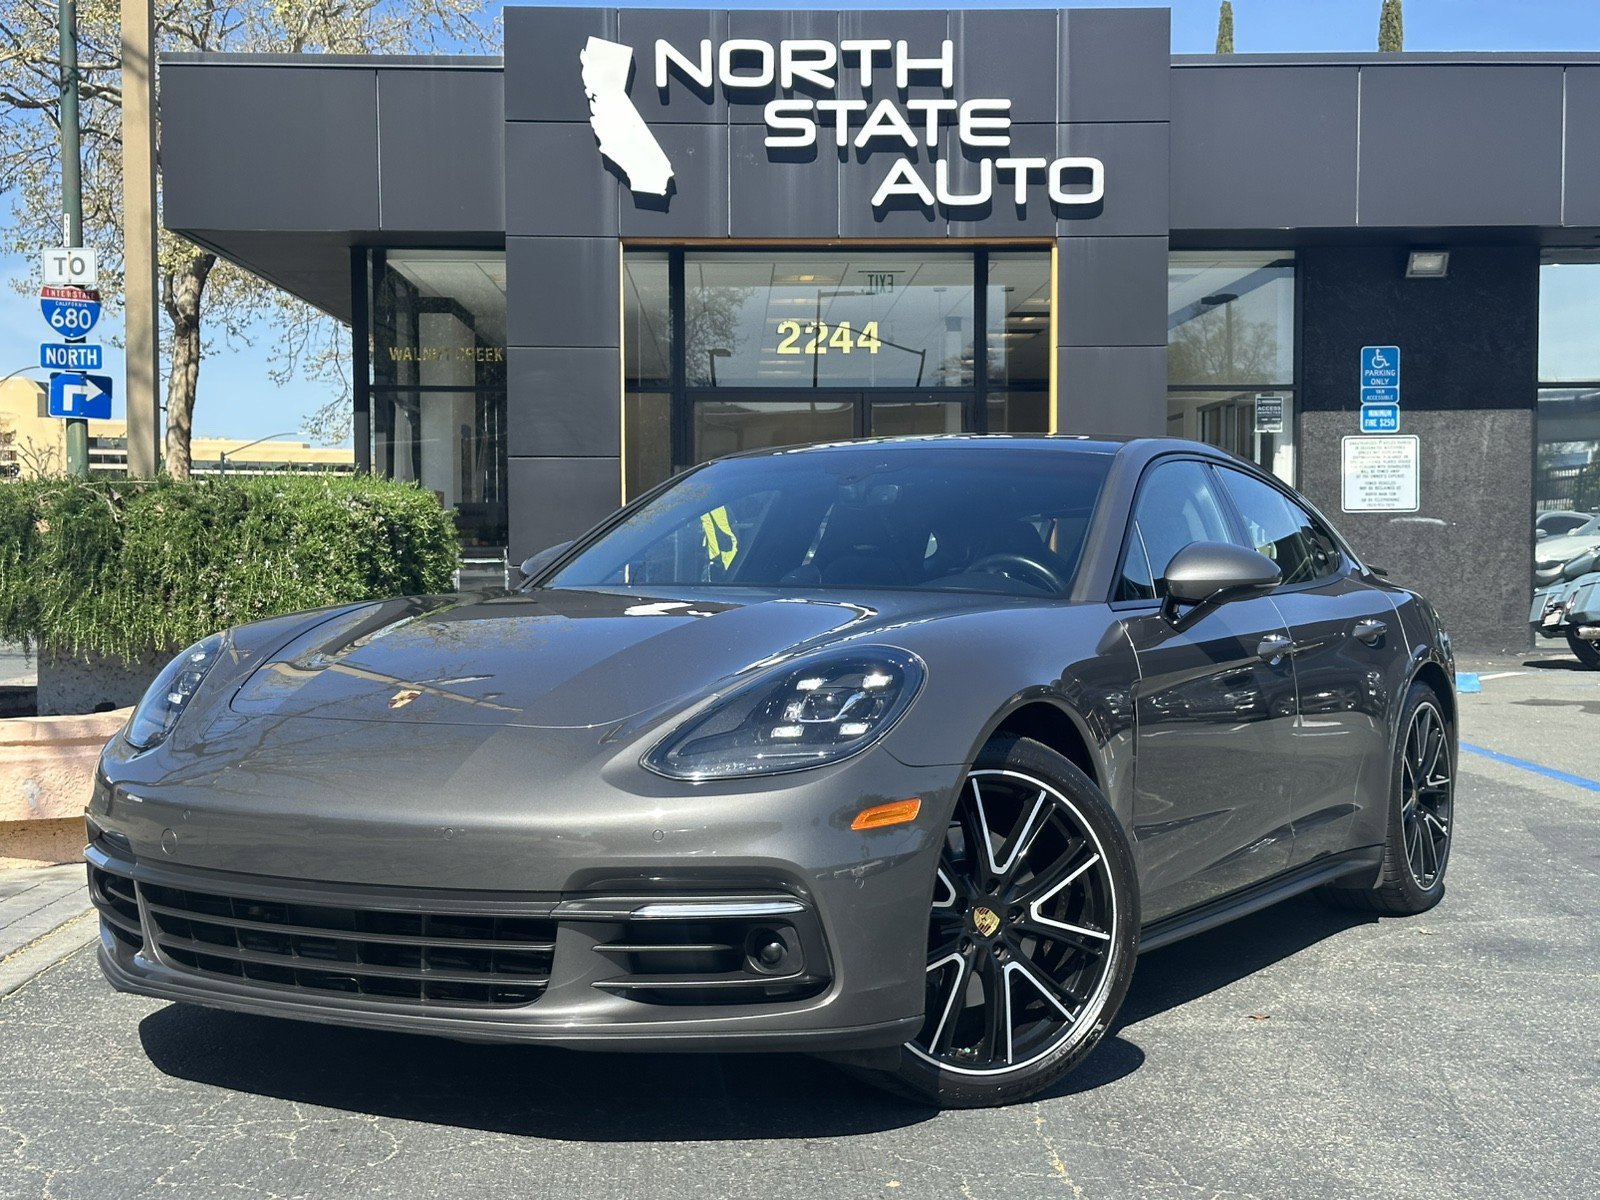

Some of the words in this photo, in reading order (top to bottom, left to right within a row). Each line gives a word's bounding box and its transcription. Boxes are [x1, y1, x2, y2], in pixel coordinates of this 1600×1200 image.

[655, 39, 953, 88] NORTH
[764, 98, 1012, 147] STATE
[871, 157, 1105, 206] AUTO
[53, 256, 86, 276] TO
[46, 288, 96, 300] INTERSTATE
[55, 300, 88, 308] CALIFORNIA
[51, 307, 92, 329] 680
[776, 321, 881, 354] 2244
[45, 347, 98, 366] NORTH
[1364, 369, 1396, 377] PARKING
[1370, 378, 1390, 386] ONLY
[1379, 418, 1396, 427] $250
